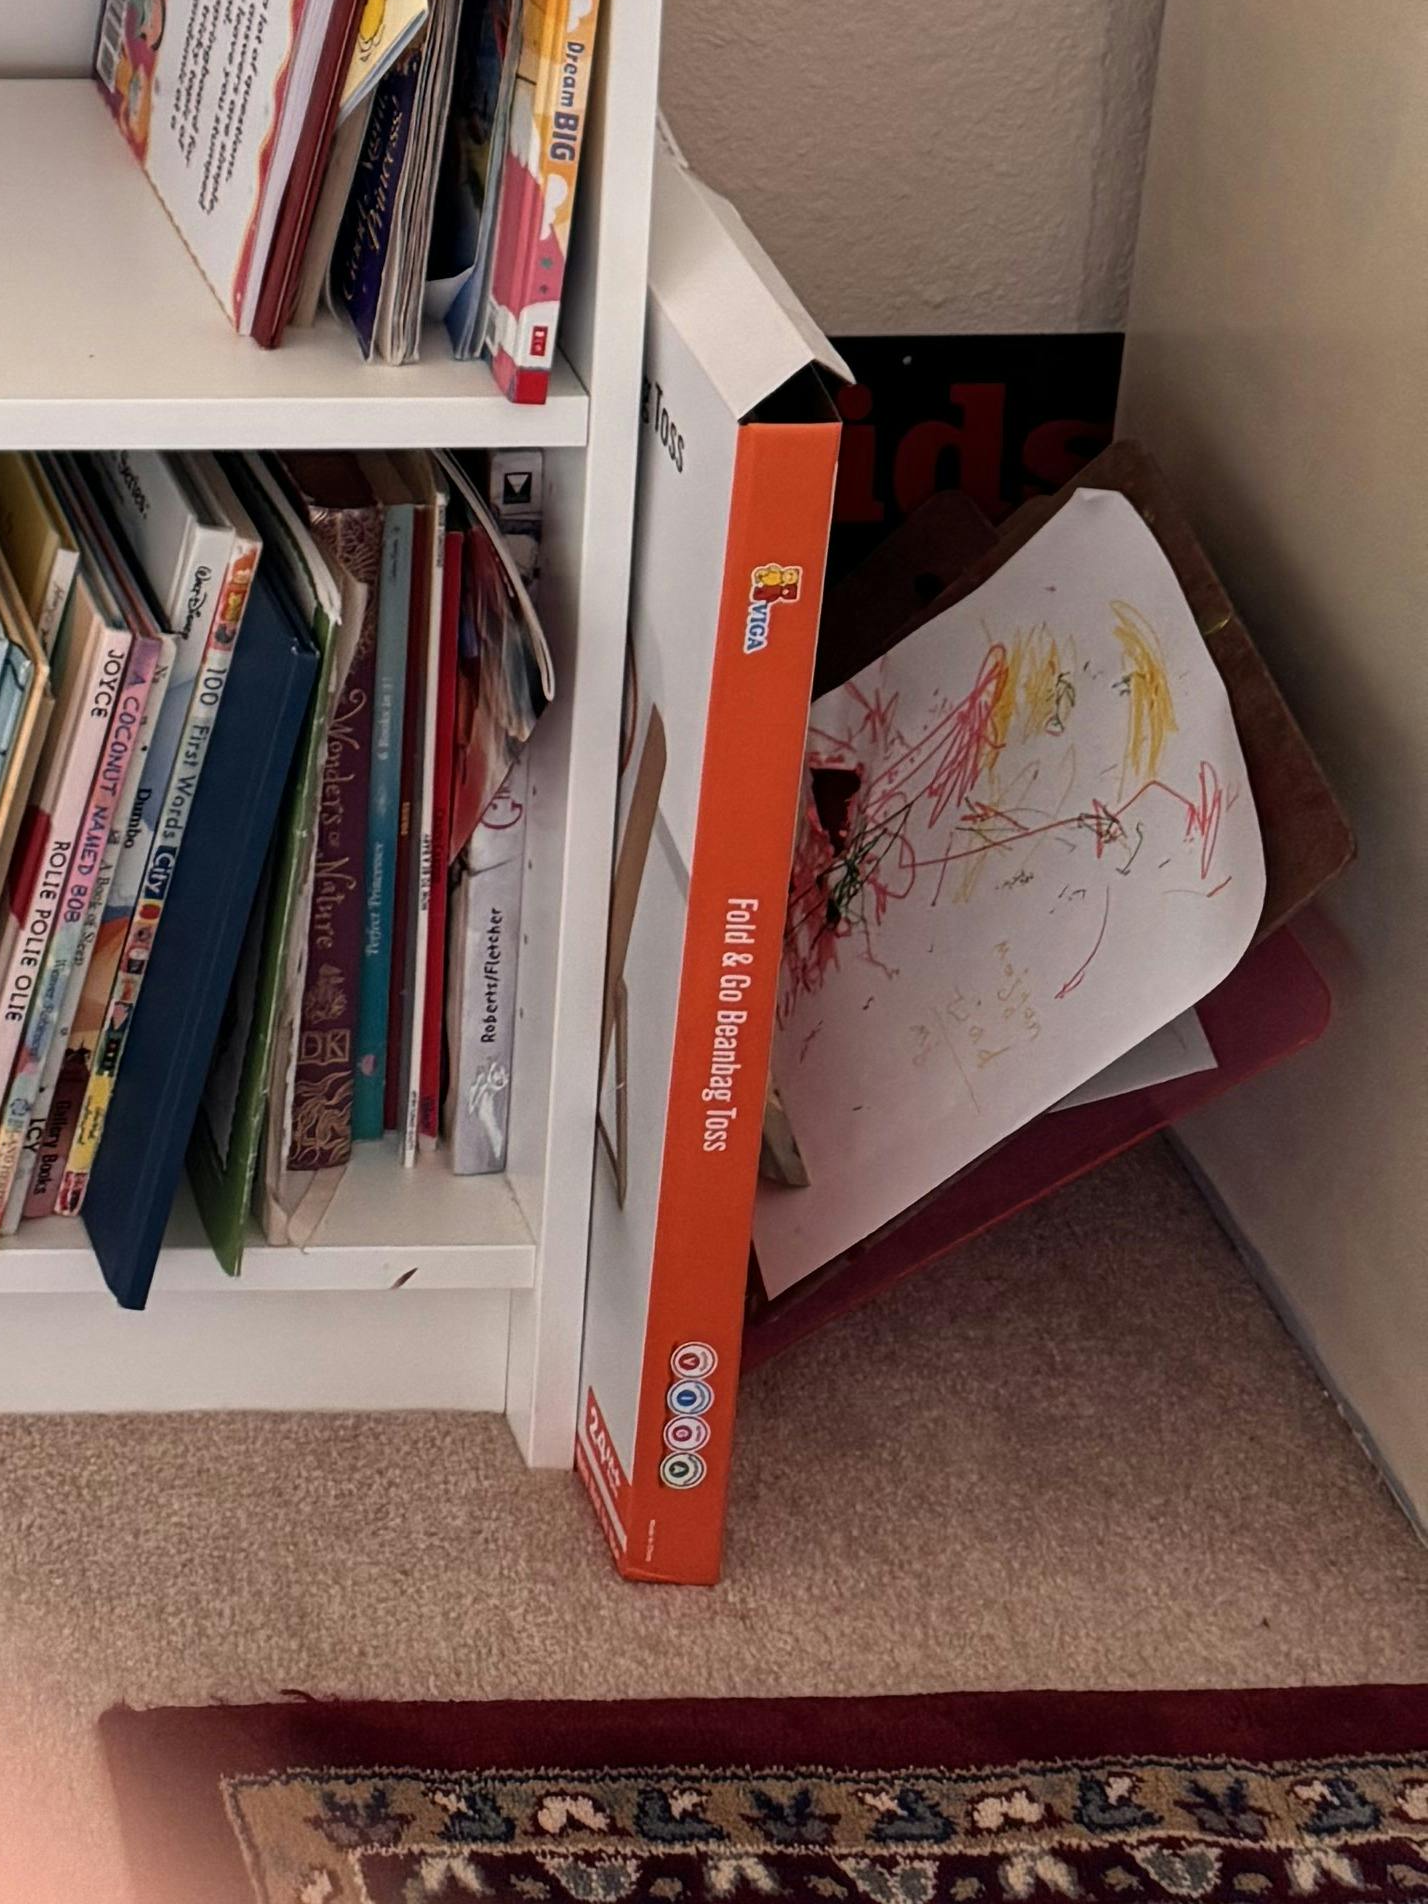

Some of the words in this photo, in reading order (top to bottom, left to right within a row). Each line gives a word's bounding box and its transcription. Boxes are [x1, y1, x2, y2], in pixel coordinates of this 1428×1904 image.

[227, 5, 245, 66] leave
[233, 2, 255, 96] answers
[560, 41, 586, 107] Dream
[225, 75, 253, 183] questions.
[549, 110, 581, 163] BIG
[197, 113, 221, 211] stumped
[654, 381, 686, 475] Toss
[746, 602, 769, 652] VIGA
[88, 648, 126, 721] JOYCE
[199, 667, 227, 707] 100
[97, 695, 141, 800] COCONUT
[182, 723, 210, 770] First
[319, 688, 367, 830] Wonders
[122, 788, 152, 849] Dumbo
[161, 775, 197, 840] Words
[40, 839, 72, 904] ROLIE
[75, 805, 108, 876] NAMED
[63, 877, 90, 924] BOB
[145, 848, 175, 898] City
[314, 850, 358, 950] Nature
[20, 908, 53, 971] POLIE
[724, 898, 760, 945] Fold
[480, 907, 503, 1044] Roberts/Fletcher
[718, 973, 752, 1003] Go
[721, 950, 754, 969] &
[5, 974, 34, 1025] OLIE
[301, 1030, 347, 1062] DK
[701, 1009, 749, 1103] Beanbag
[23, 1117, 45, 1156] LCY
[702, 1106, 738, 1153] Toss
